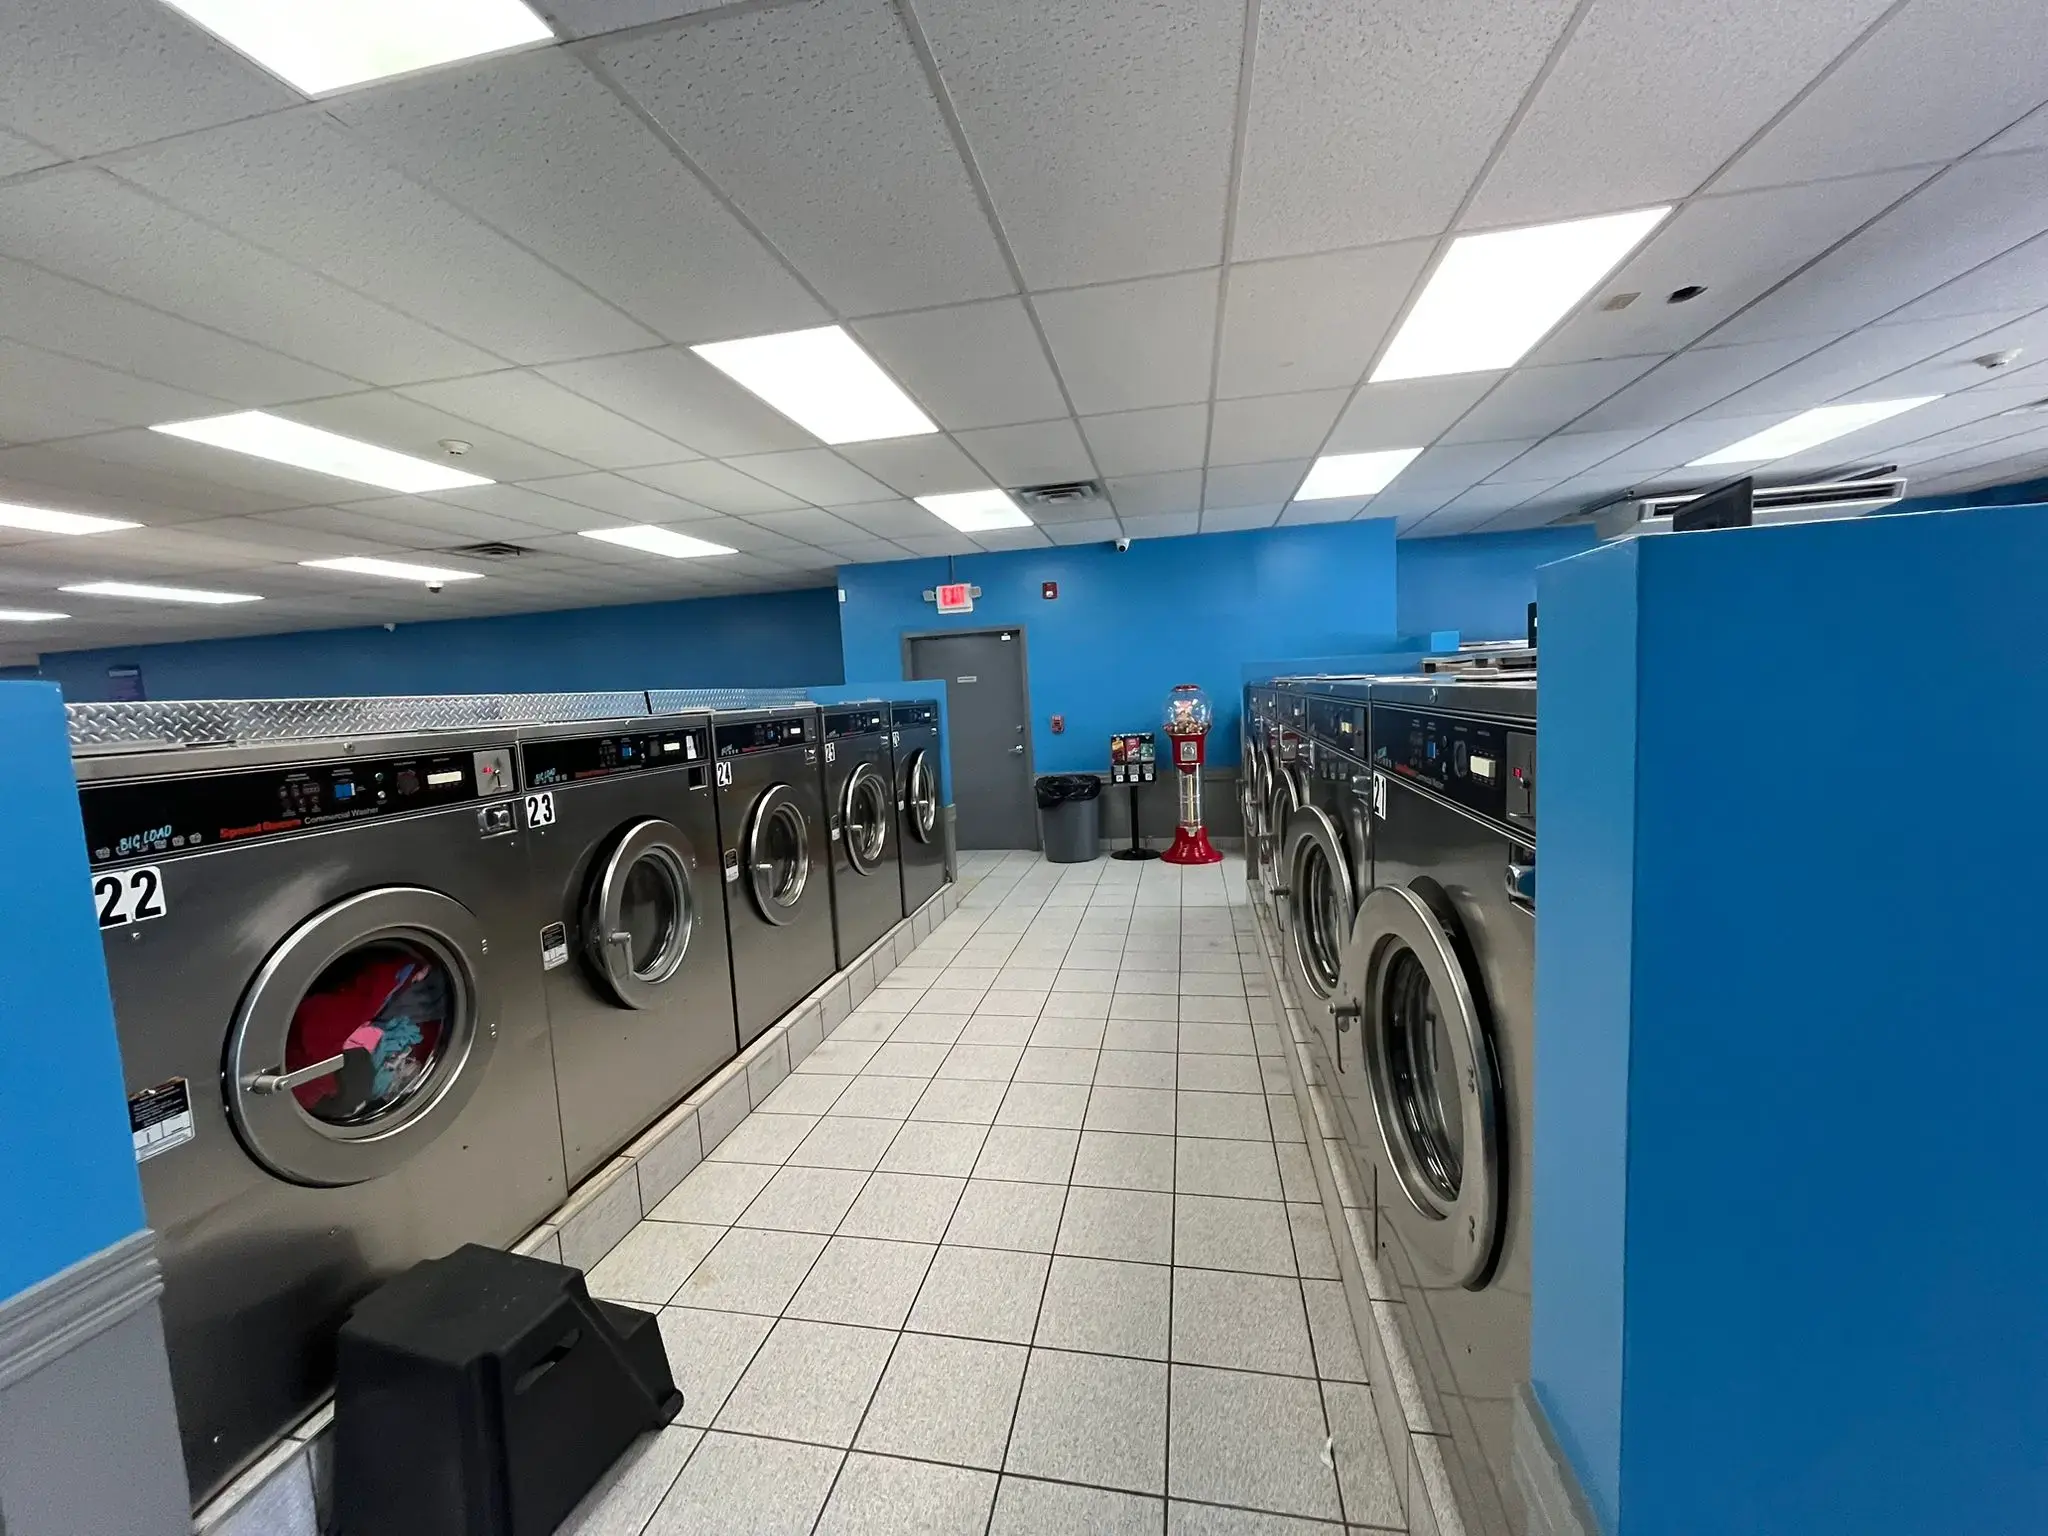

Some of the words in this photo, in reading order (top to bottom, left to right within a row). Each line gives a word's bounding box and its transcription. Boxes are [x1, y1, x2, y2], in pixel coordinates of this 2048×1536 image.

[717, 763, 732, 786] 24
[528, 794, 553, 827] 23
[1374, 774, 1385, 817] 21
[304, 810, 351, 825] Commercial
[351, 806, 379, 818] Washer
[119, 833, 141, 852] BIG
[143, 824, 173, 844] LOAD
[94, 869, 162, 928] 22
